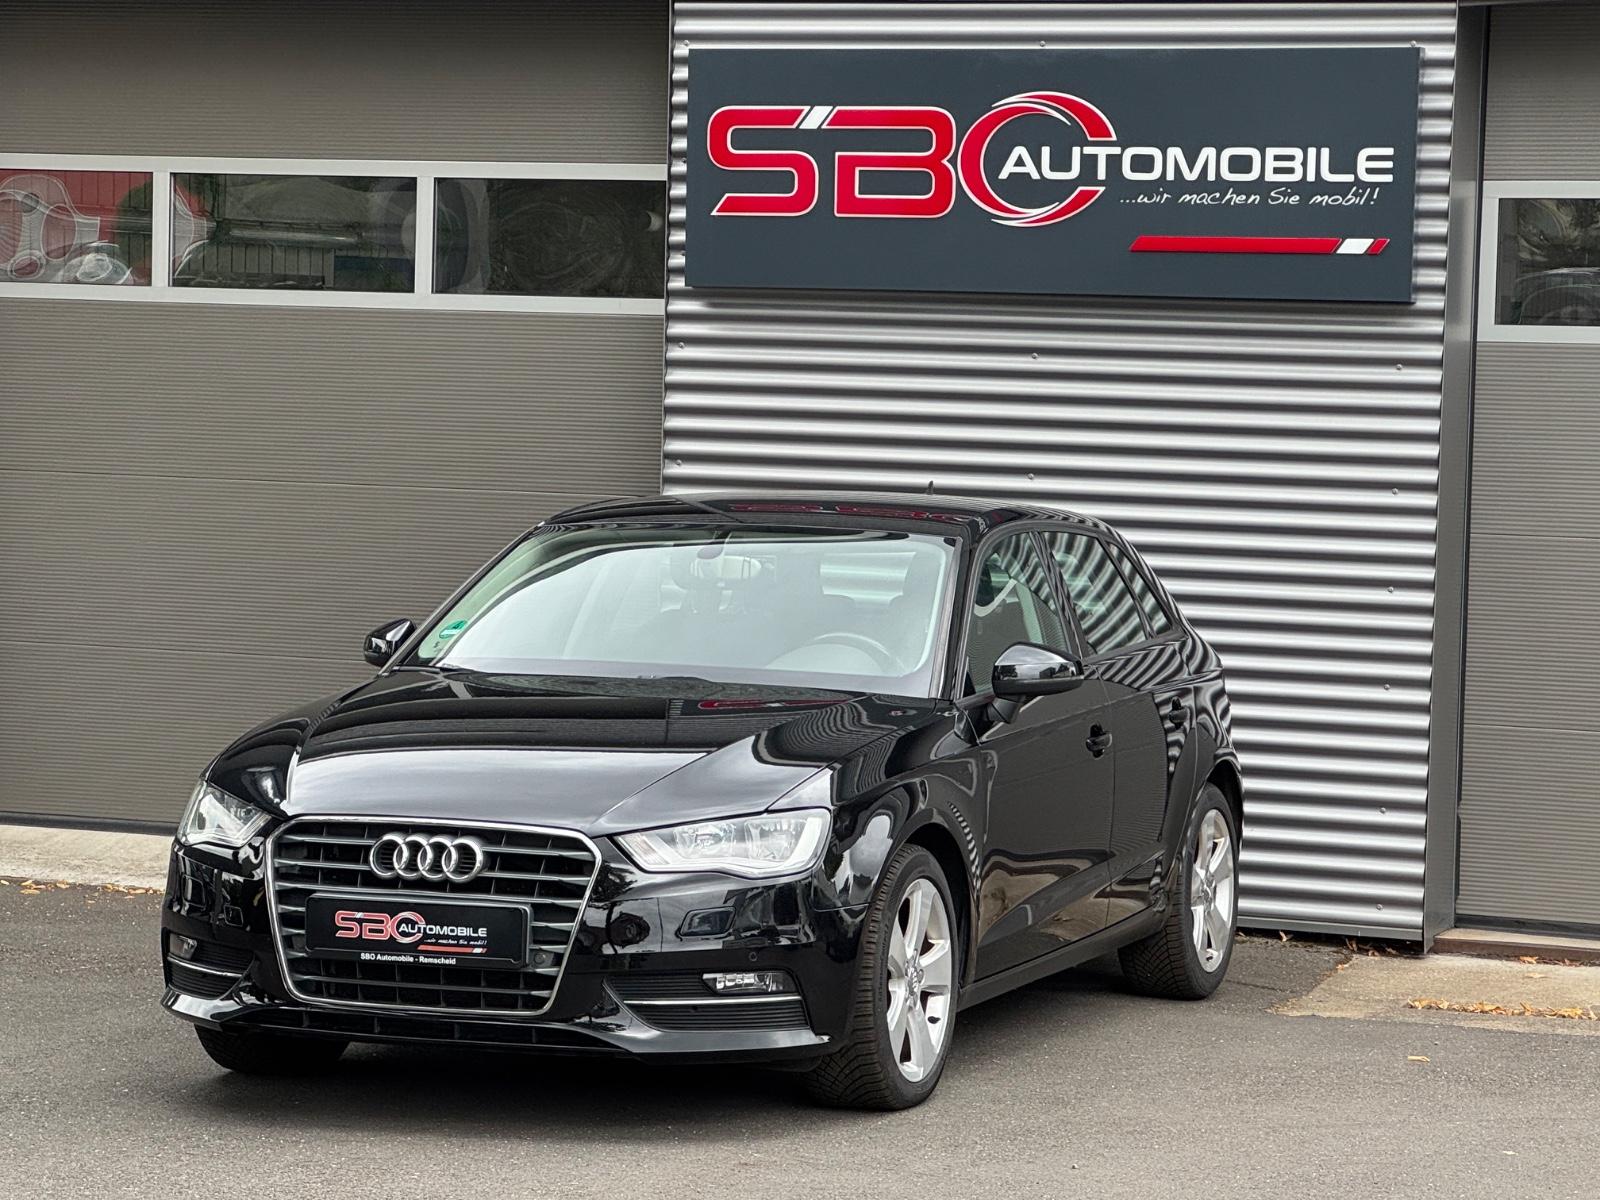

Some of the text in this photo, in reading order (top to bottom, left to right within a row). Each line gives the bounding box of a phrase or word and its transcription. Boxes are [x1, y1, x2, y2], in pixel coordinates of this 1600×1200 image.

[997, 146, 1395, 183] AUTOMOBILE
[1178, 187, 1261, 206] machen
[1267, 187, 1301, 206] Sie
[1308, 186, 1380, 207] mobil!
[398, 923, 488, 937] AUTOMOBILE
[360, 952, 376, 961] SBO
[376, 953, 414, 963] Automobile
[419, 955, 457, 965] Remscheid
